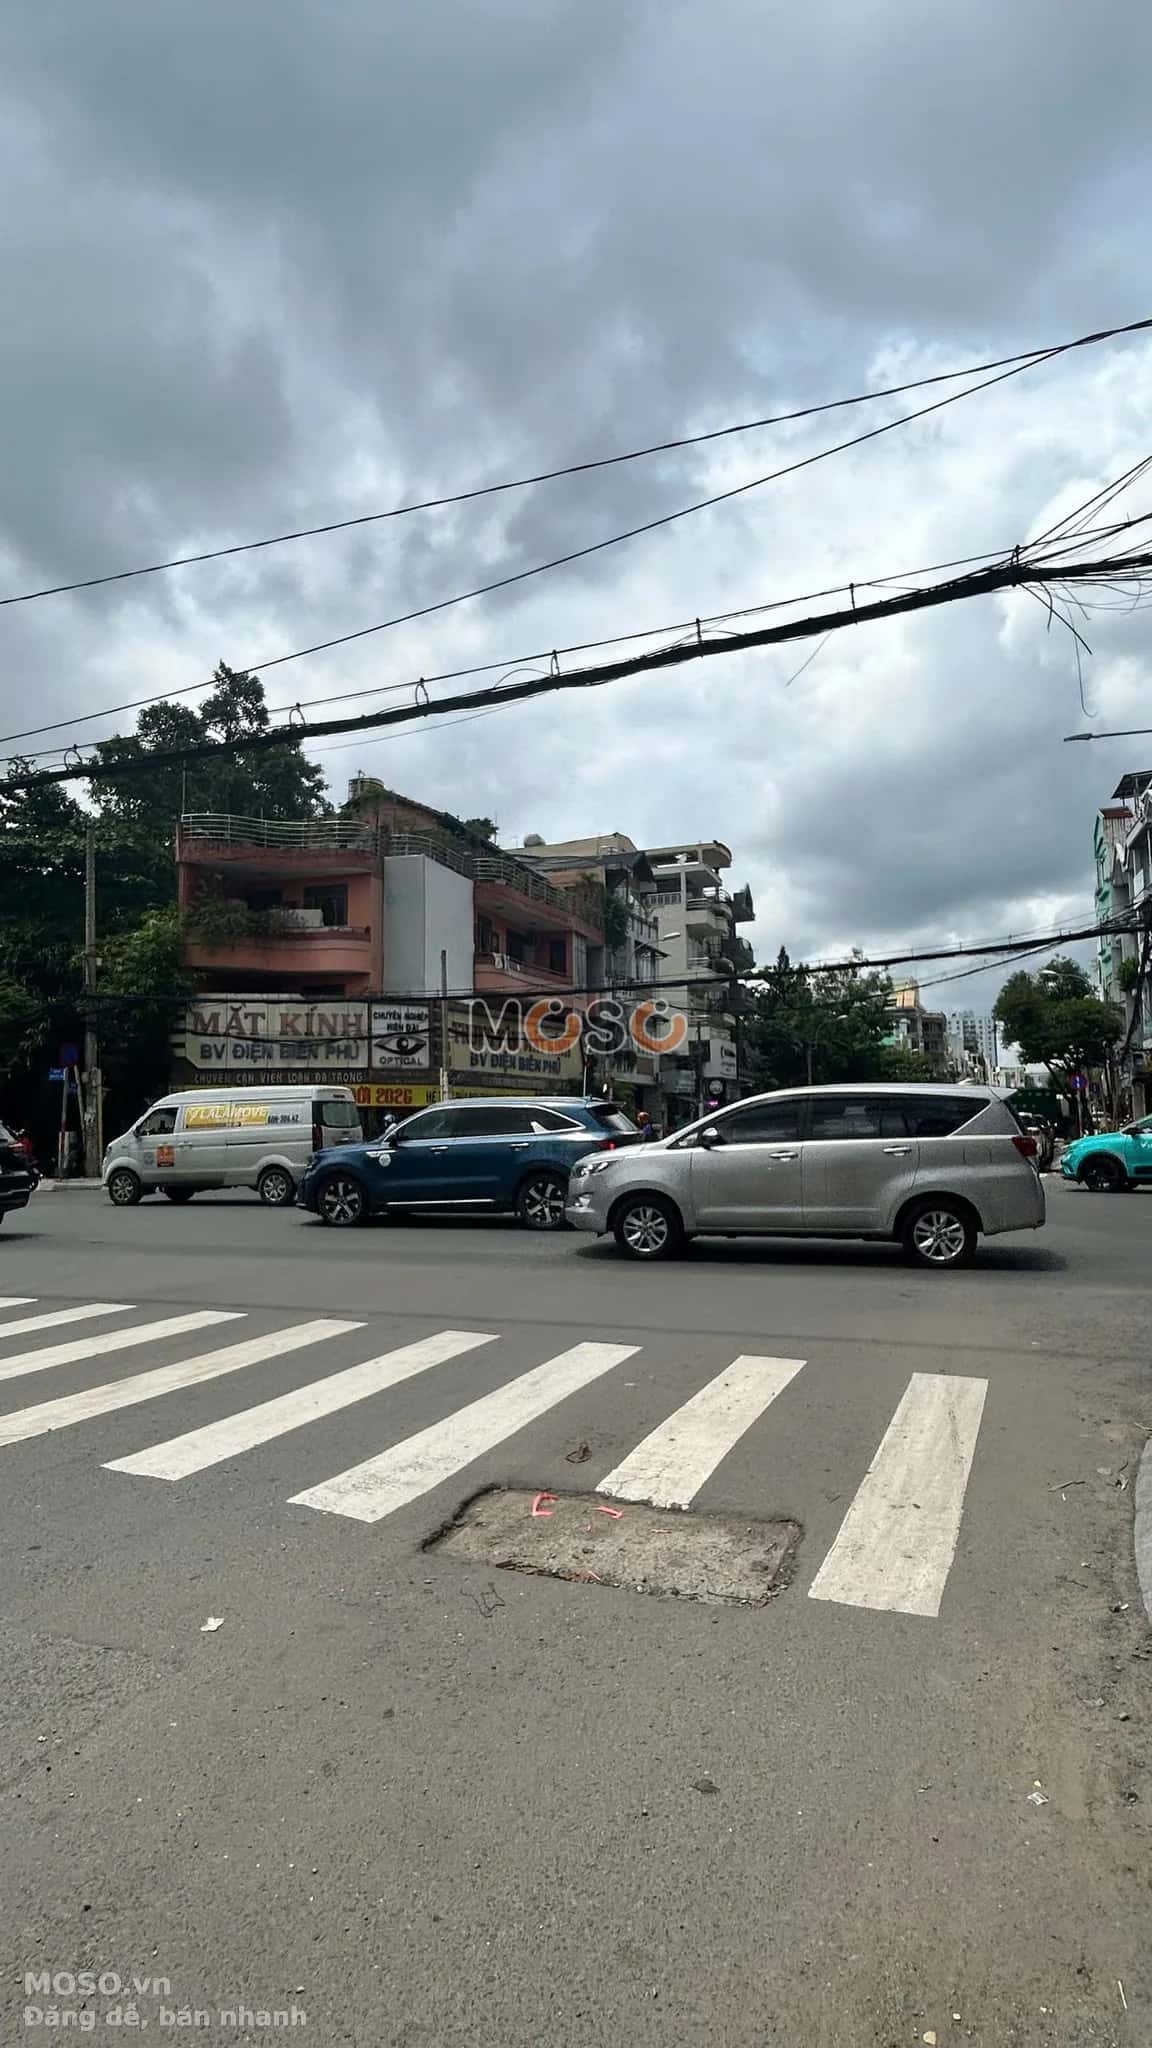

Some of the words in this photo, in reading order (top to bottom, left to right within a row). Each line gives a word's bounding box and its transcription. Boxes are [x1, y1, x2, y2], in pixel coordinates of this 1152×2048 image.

[279, 1006, 364, 1037] KÍNH
[200, 1043, 225, 1060] BV
[379, 1056, 423, 1066] OPTICAL
[470, 1052, 488, 1067] BV
[200, 1105, 267, 1120] LALAMOVE
